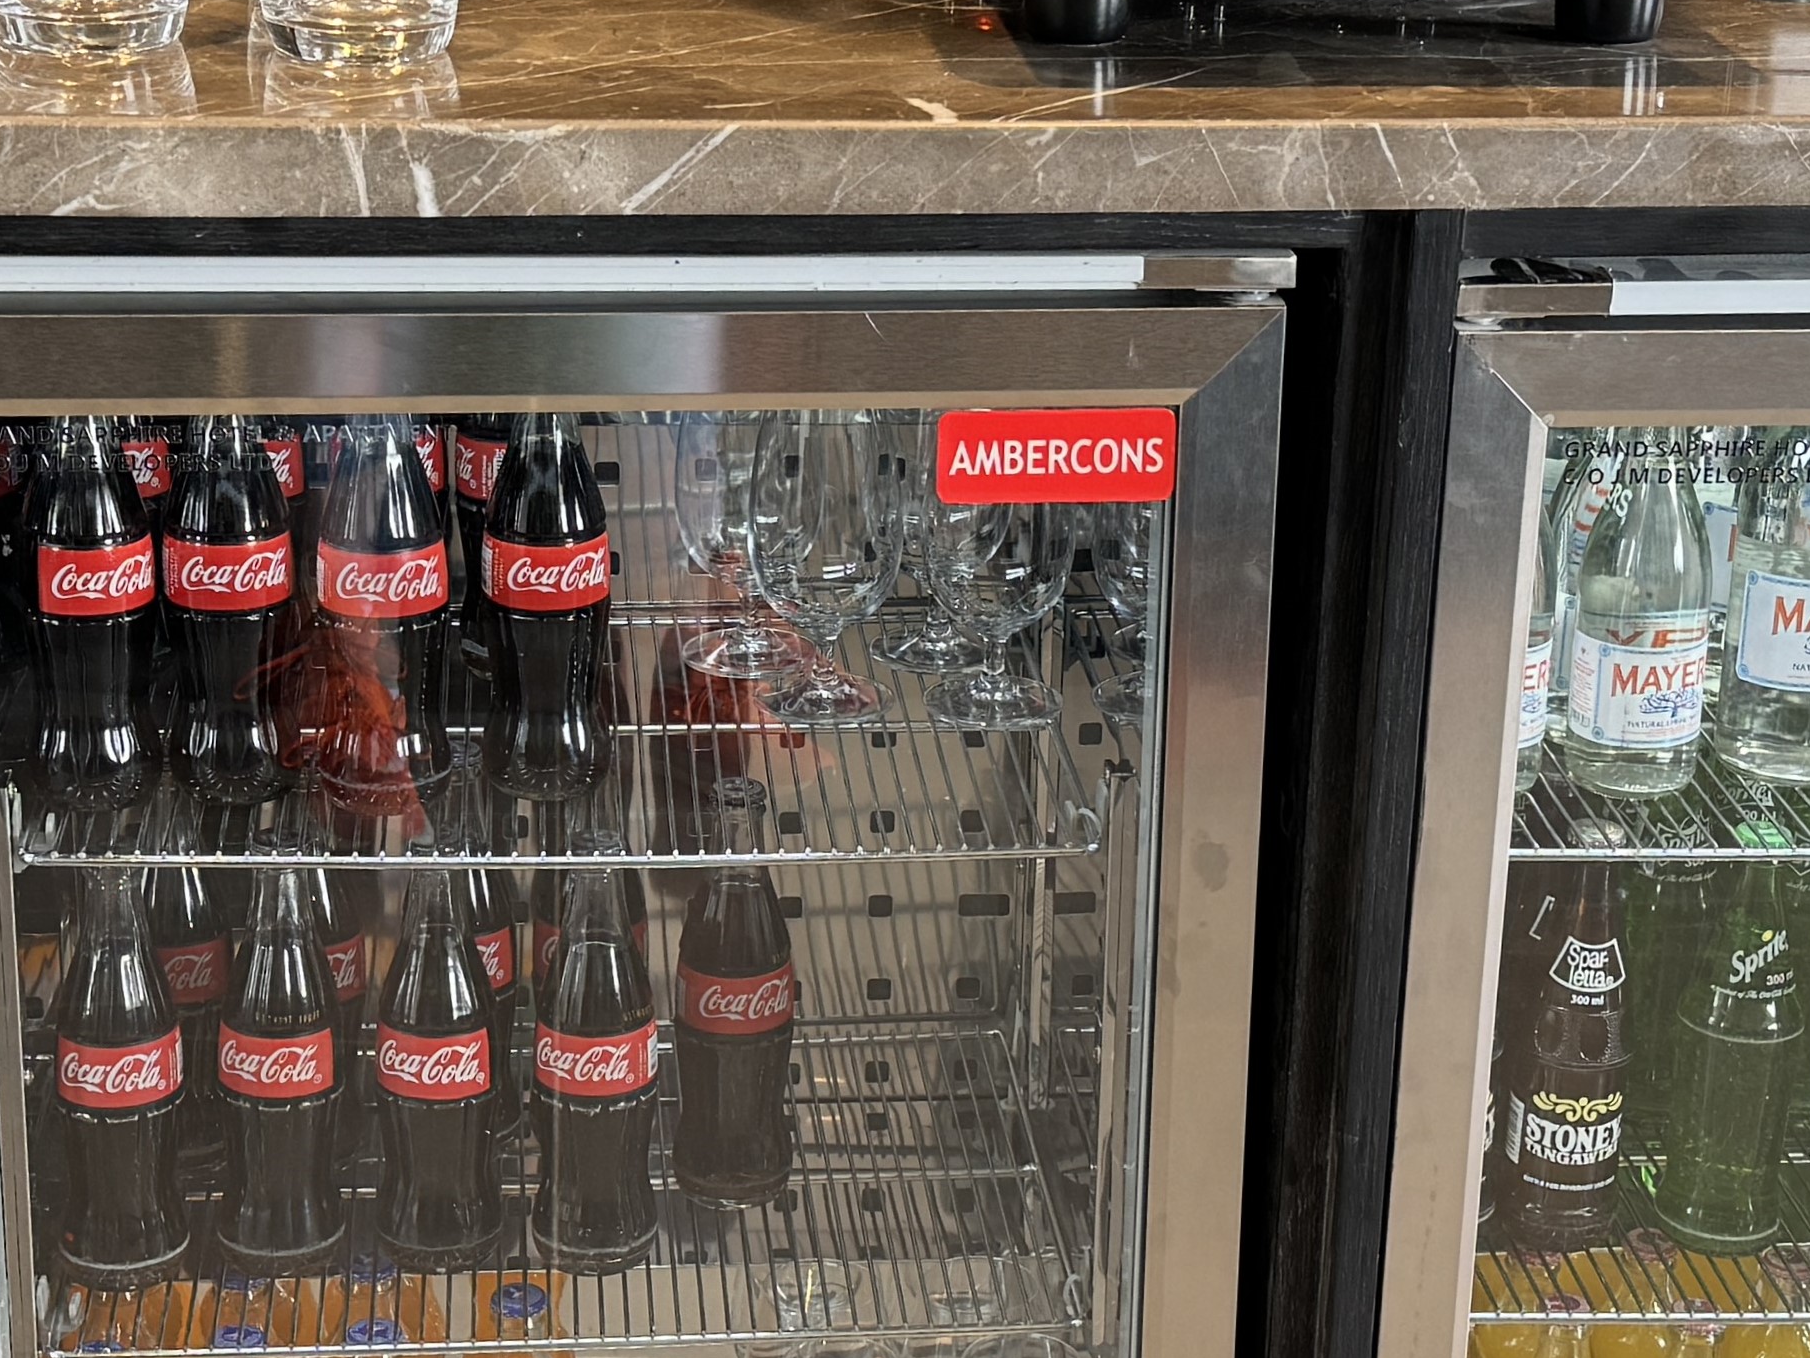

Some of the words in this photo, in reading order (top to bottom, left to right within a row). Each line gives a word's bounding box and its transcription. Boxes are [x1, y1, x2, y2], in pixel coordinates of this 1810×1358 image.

[62, 425, 184, 445] SAPPHIRE
[1564, 440, 1654, 458] GRAND
[1655, 440, 1766, 458] SAPPHIRE
[69, 452, 222, 472] DEVELOPERS
[230, 452, 272, 472] LTD
[948, 438, 1164, 477] AMBERCONS
[1629, 467, 1649, 485] M
[1657, 467, 1799, 485] DEVELOPERS
[50, 550, 155, 600] Coca-Cola
[180, 546, 288, 596] Coca-Cola
[335, 554, 439, 604] Coca-Cola
[506, 546, 606, 596] Coca-Cola
[1610, 655, 1705, 698] MAYER
[1728, 928, 1789, 984] Sprite
[698, 975, 789, 1021] Coca-Cola
[1570, 993, 1590, 1006] 300
[1591, 994, 1605, 1006] ml
[1766, 973, 1786, 986] 300
[60, 1051, 162, 1094] Coca-Cola
[221, 1039, 319, 1084] Coca-Cola
[379, 1038, 480, 1085] Coca-Cola
[537, 1036, 631, 1084] Coca-Cola
[1525, 1113, 1622, 1154] STONEY
